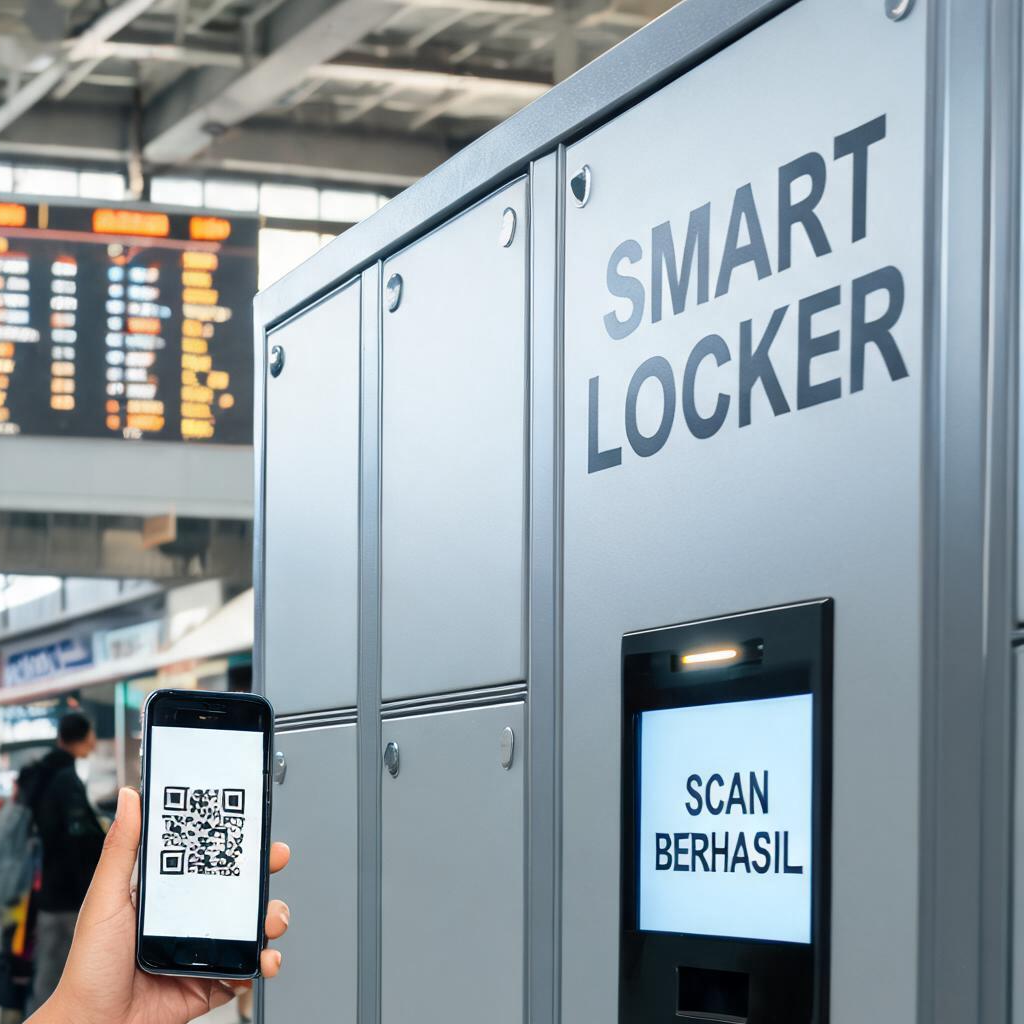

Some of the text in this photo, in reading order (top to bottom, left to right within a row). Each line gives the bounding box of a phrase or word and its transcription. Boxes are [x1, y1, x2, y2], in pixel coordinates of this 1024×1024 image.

[602, 113, 887, 341] SMART
[587, 265, 910, 474] LOCKER
[655, 831, 804, 875] BERHASIL
[684, 769, 769, 817] SCAN
